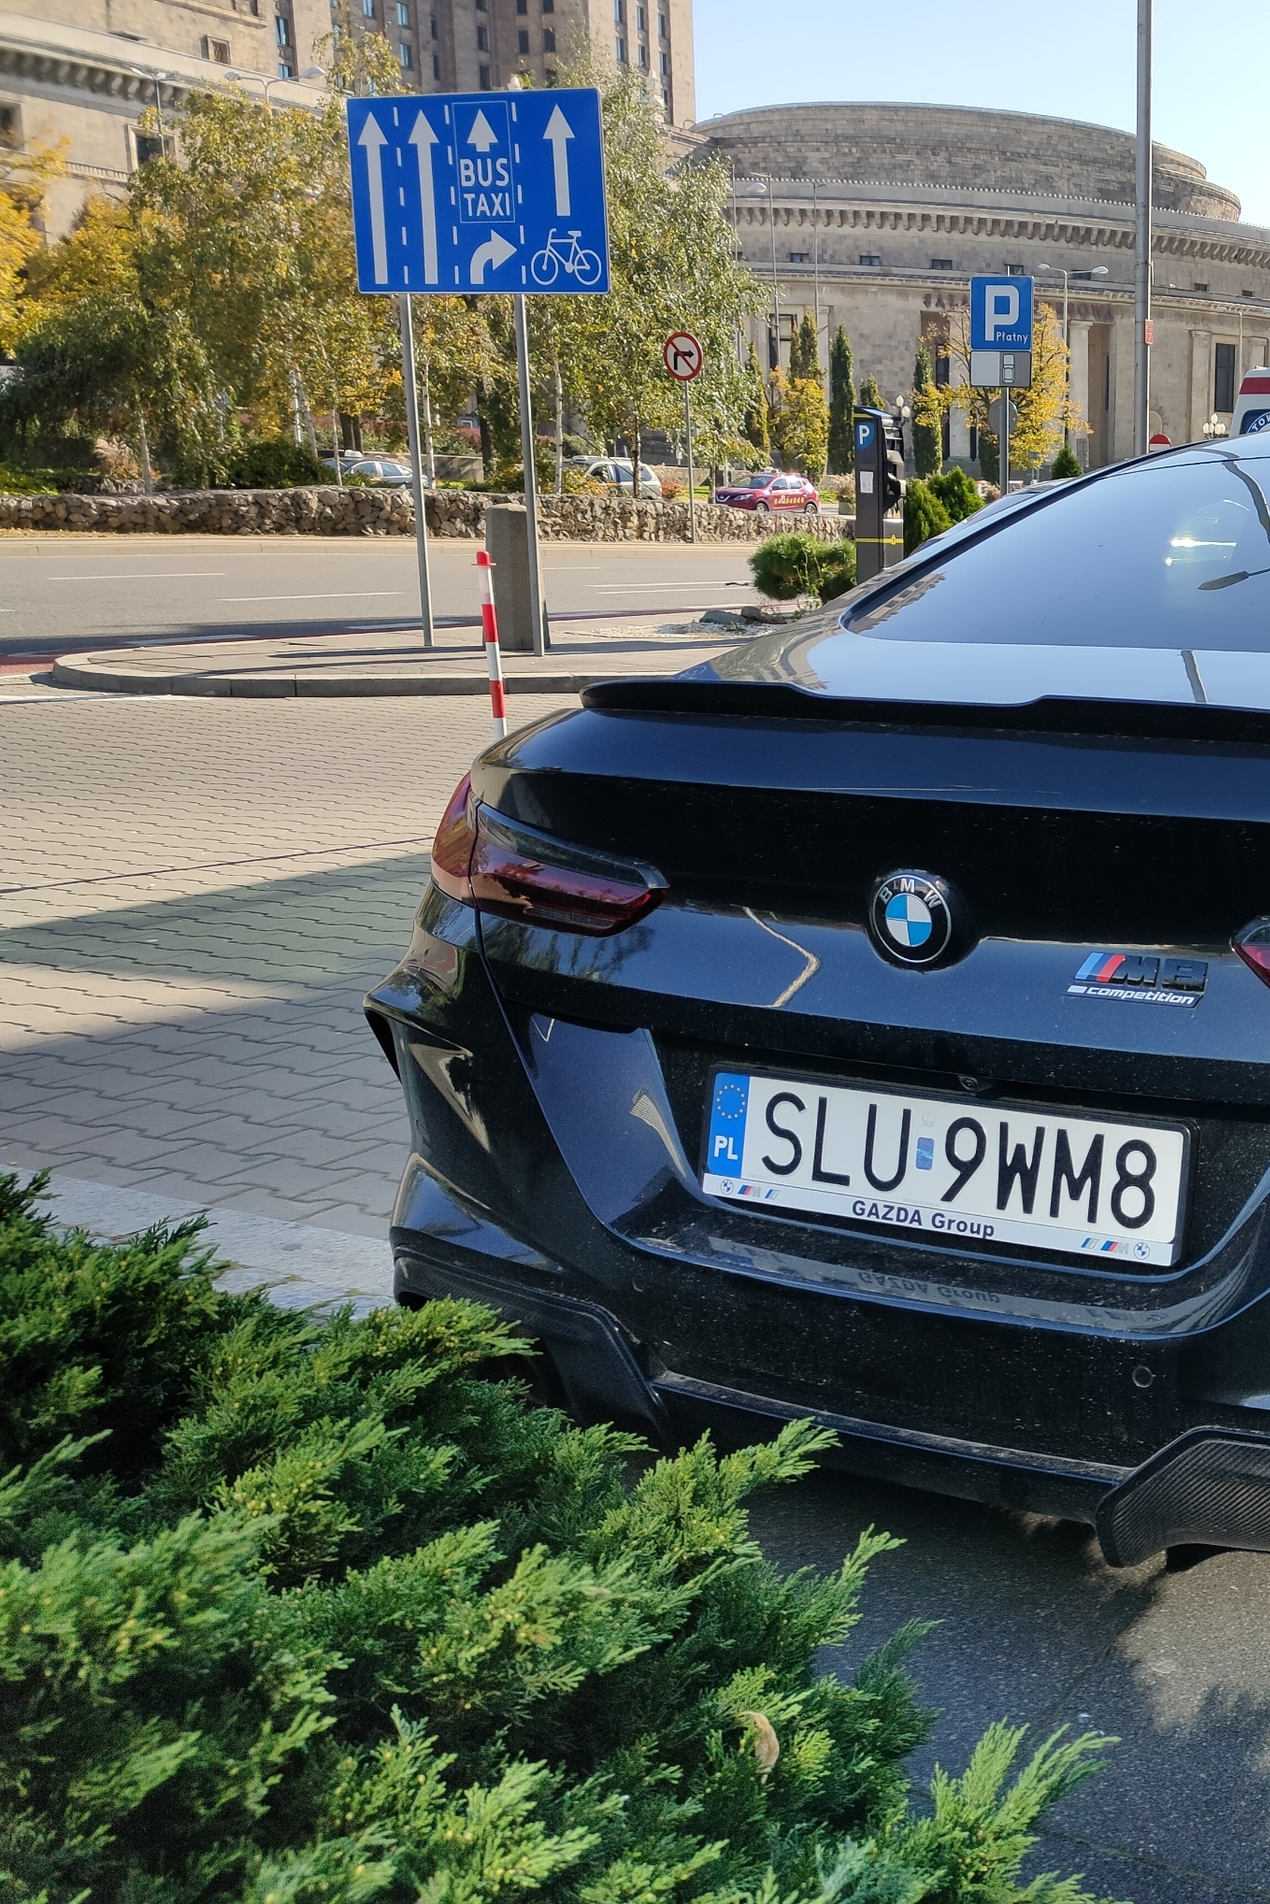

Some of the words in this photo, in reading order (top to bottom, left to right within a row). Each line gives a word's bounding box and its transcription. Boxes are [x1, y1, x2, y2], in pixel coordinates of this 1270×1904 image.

[460, 157, 509, 187] BUS
[463, 192, 511, 217] TAXI
[985, 284, 1020, 342] P
[996, 330, 1029, 344] Płatny
[859, 424, 870, 445] P
[879, 878, 942, 909] BMW
[1086, 986, 1195, 1005] competition
[713, 1135, 739, 1161] PL
[762, 1091, 912, 1192] SLU
[940, 1117, 1157, 1229] 9WM8
[851, 1200, 923, 1226] GAZDA
[931, 1212, 996, 1239] Group
